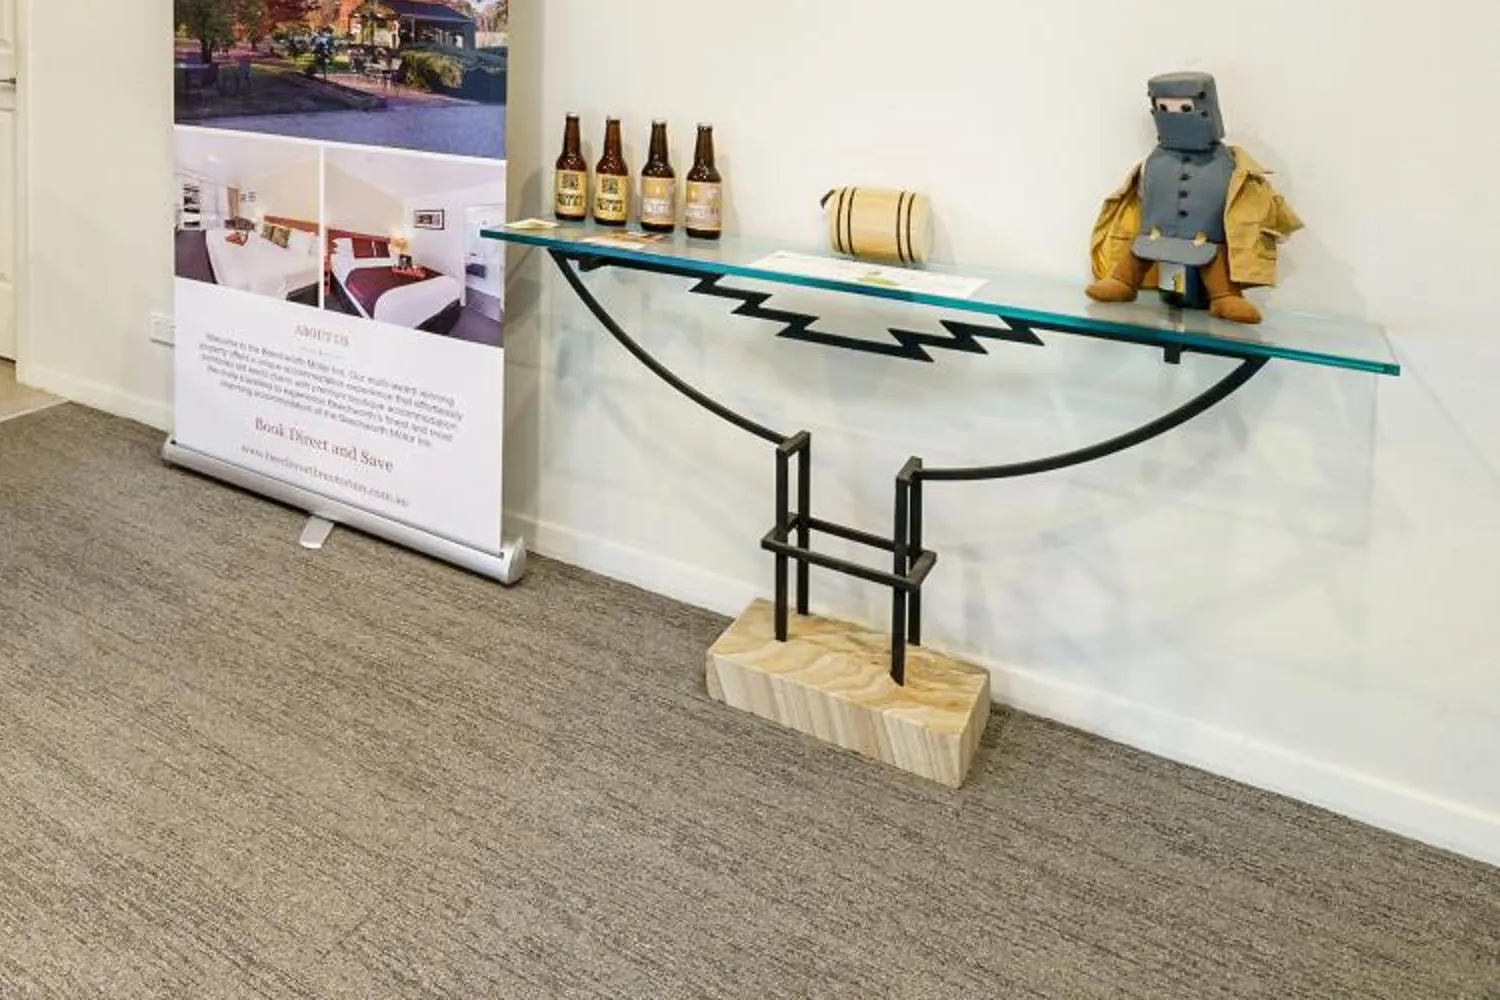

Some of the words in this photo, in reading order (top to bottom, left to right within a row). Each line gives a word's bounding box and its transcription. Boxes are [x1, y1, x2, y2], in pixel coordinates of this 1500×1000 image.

[255, 416, 285, 437] Book
[289, 427, 328, 451] Direct
[331, 443, 357, 461] and
[360, 450, 394, 473] Save
